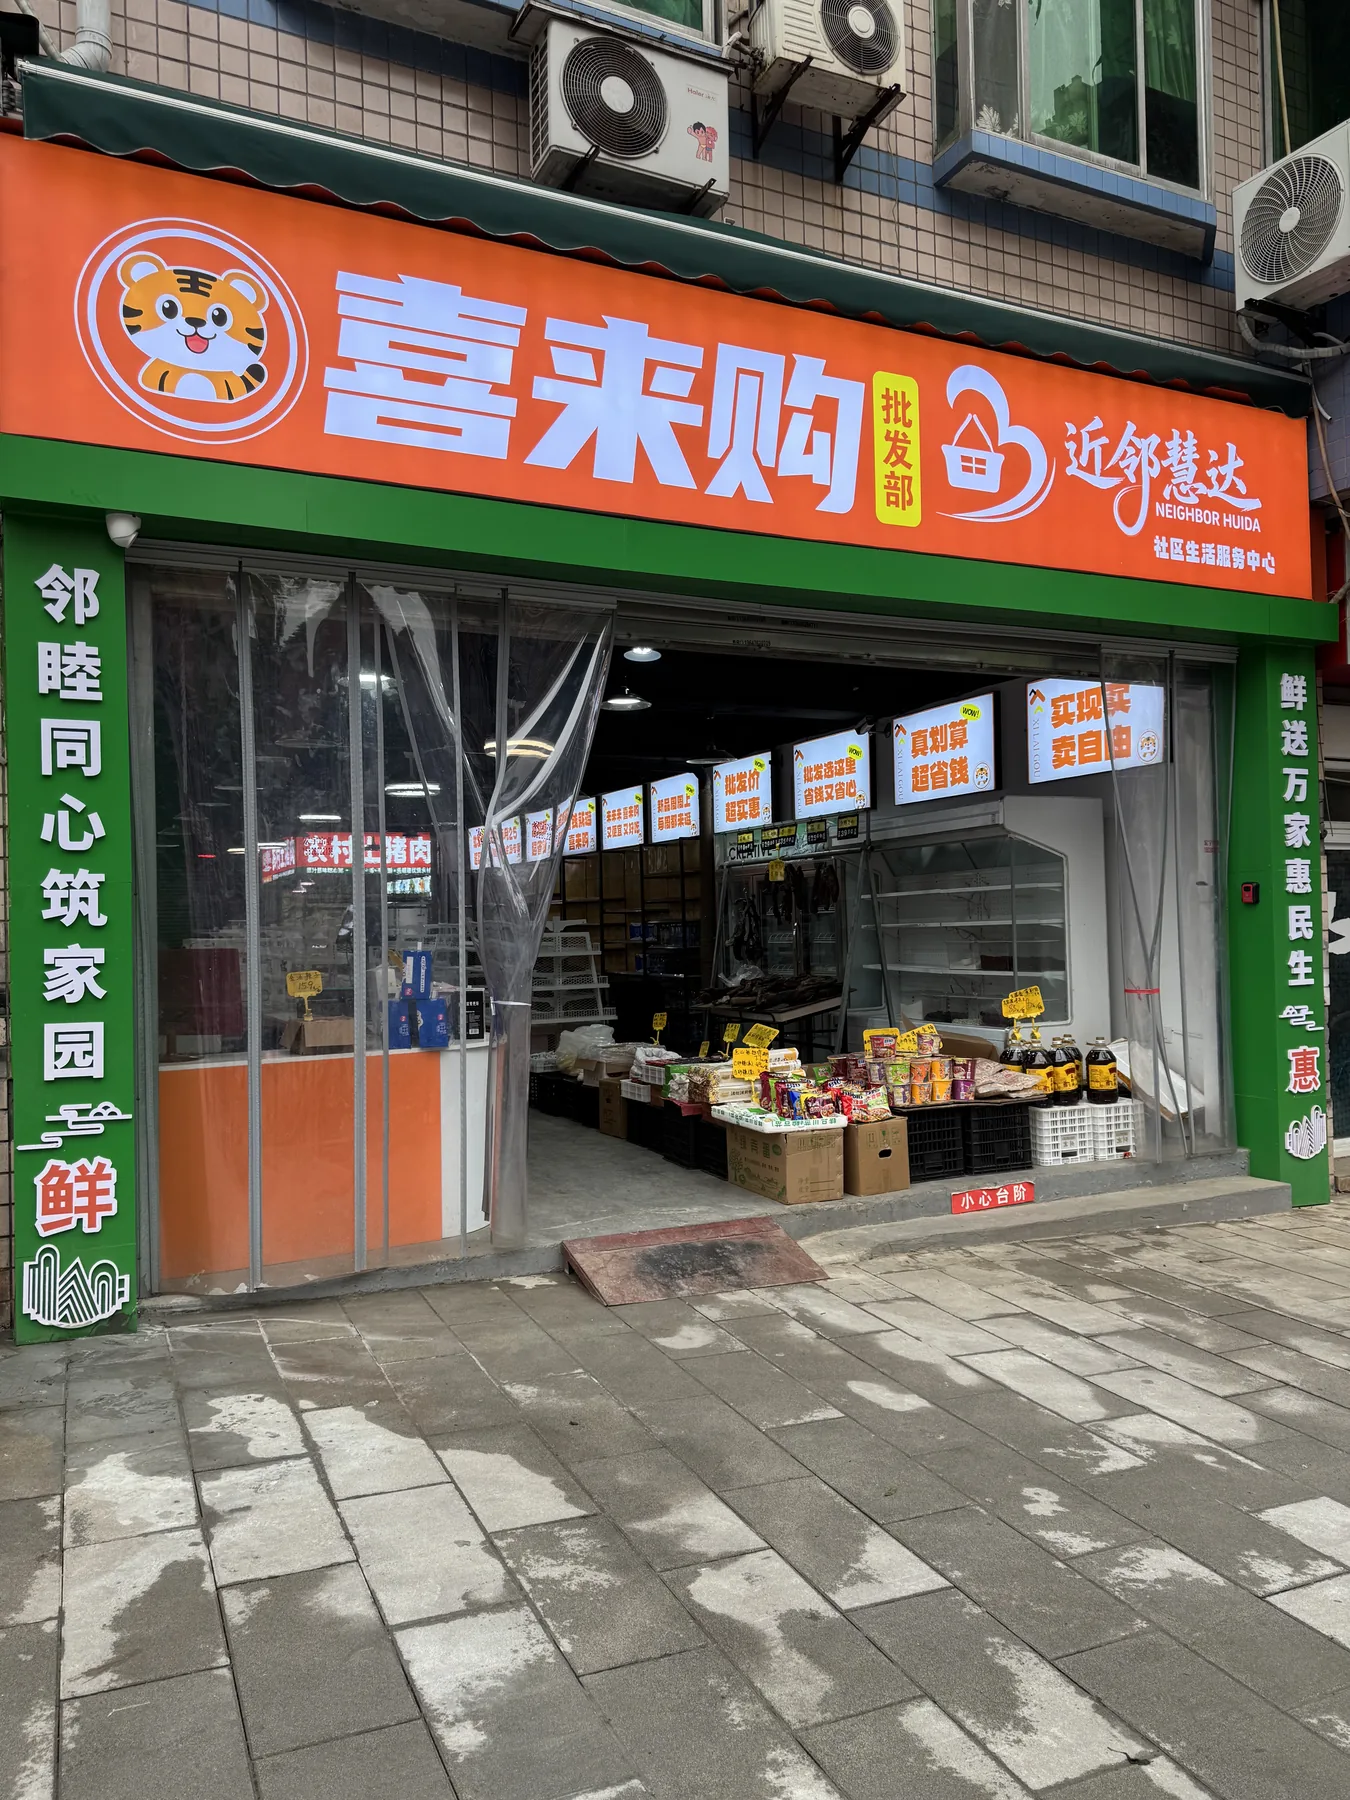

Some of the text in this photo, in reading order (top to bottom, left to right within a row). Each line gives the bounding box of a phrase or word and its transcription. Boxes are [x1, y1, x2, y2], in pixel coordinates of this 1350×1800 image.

[323, 270, 866, 514] 喜来购
[881, 387, 914, 511] 批发部
[1065, 416, 1262, 536] 近邻慧达
[1155, 501, 1261, 532] NEIGHBOR HUIDA
[1154, 535, 1275, 574] 社区生活服务中心
[961, 706, 980, 718] WOW!
[911, 719, 969, 759] 真划算
[1033, 732, 1041, 752] LAI
[1052, 724, 1132, 770] 卖自由
[724, 768, 760, 796] 批发价
[803, 757, 857, 784] 批发选这里
[911, 756, 969, 793] 超省钱
[1033, 753, 1041, 778] GOU
[725, 796, 761, 823] 超实惠
[803, 779, 857, 806] 省钱又省心
[34, 563, 108, 1082] 邻睦同心筑家园
[1280, 673, 1315, 986] 鲜送万家惠民生
[1288, 1046, 1320, 1093] 惠
[36, 1158, 116, 1236] 鲜
[961, 1184, 1026, 1210] 小心台阶
